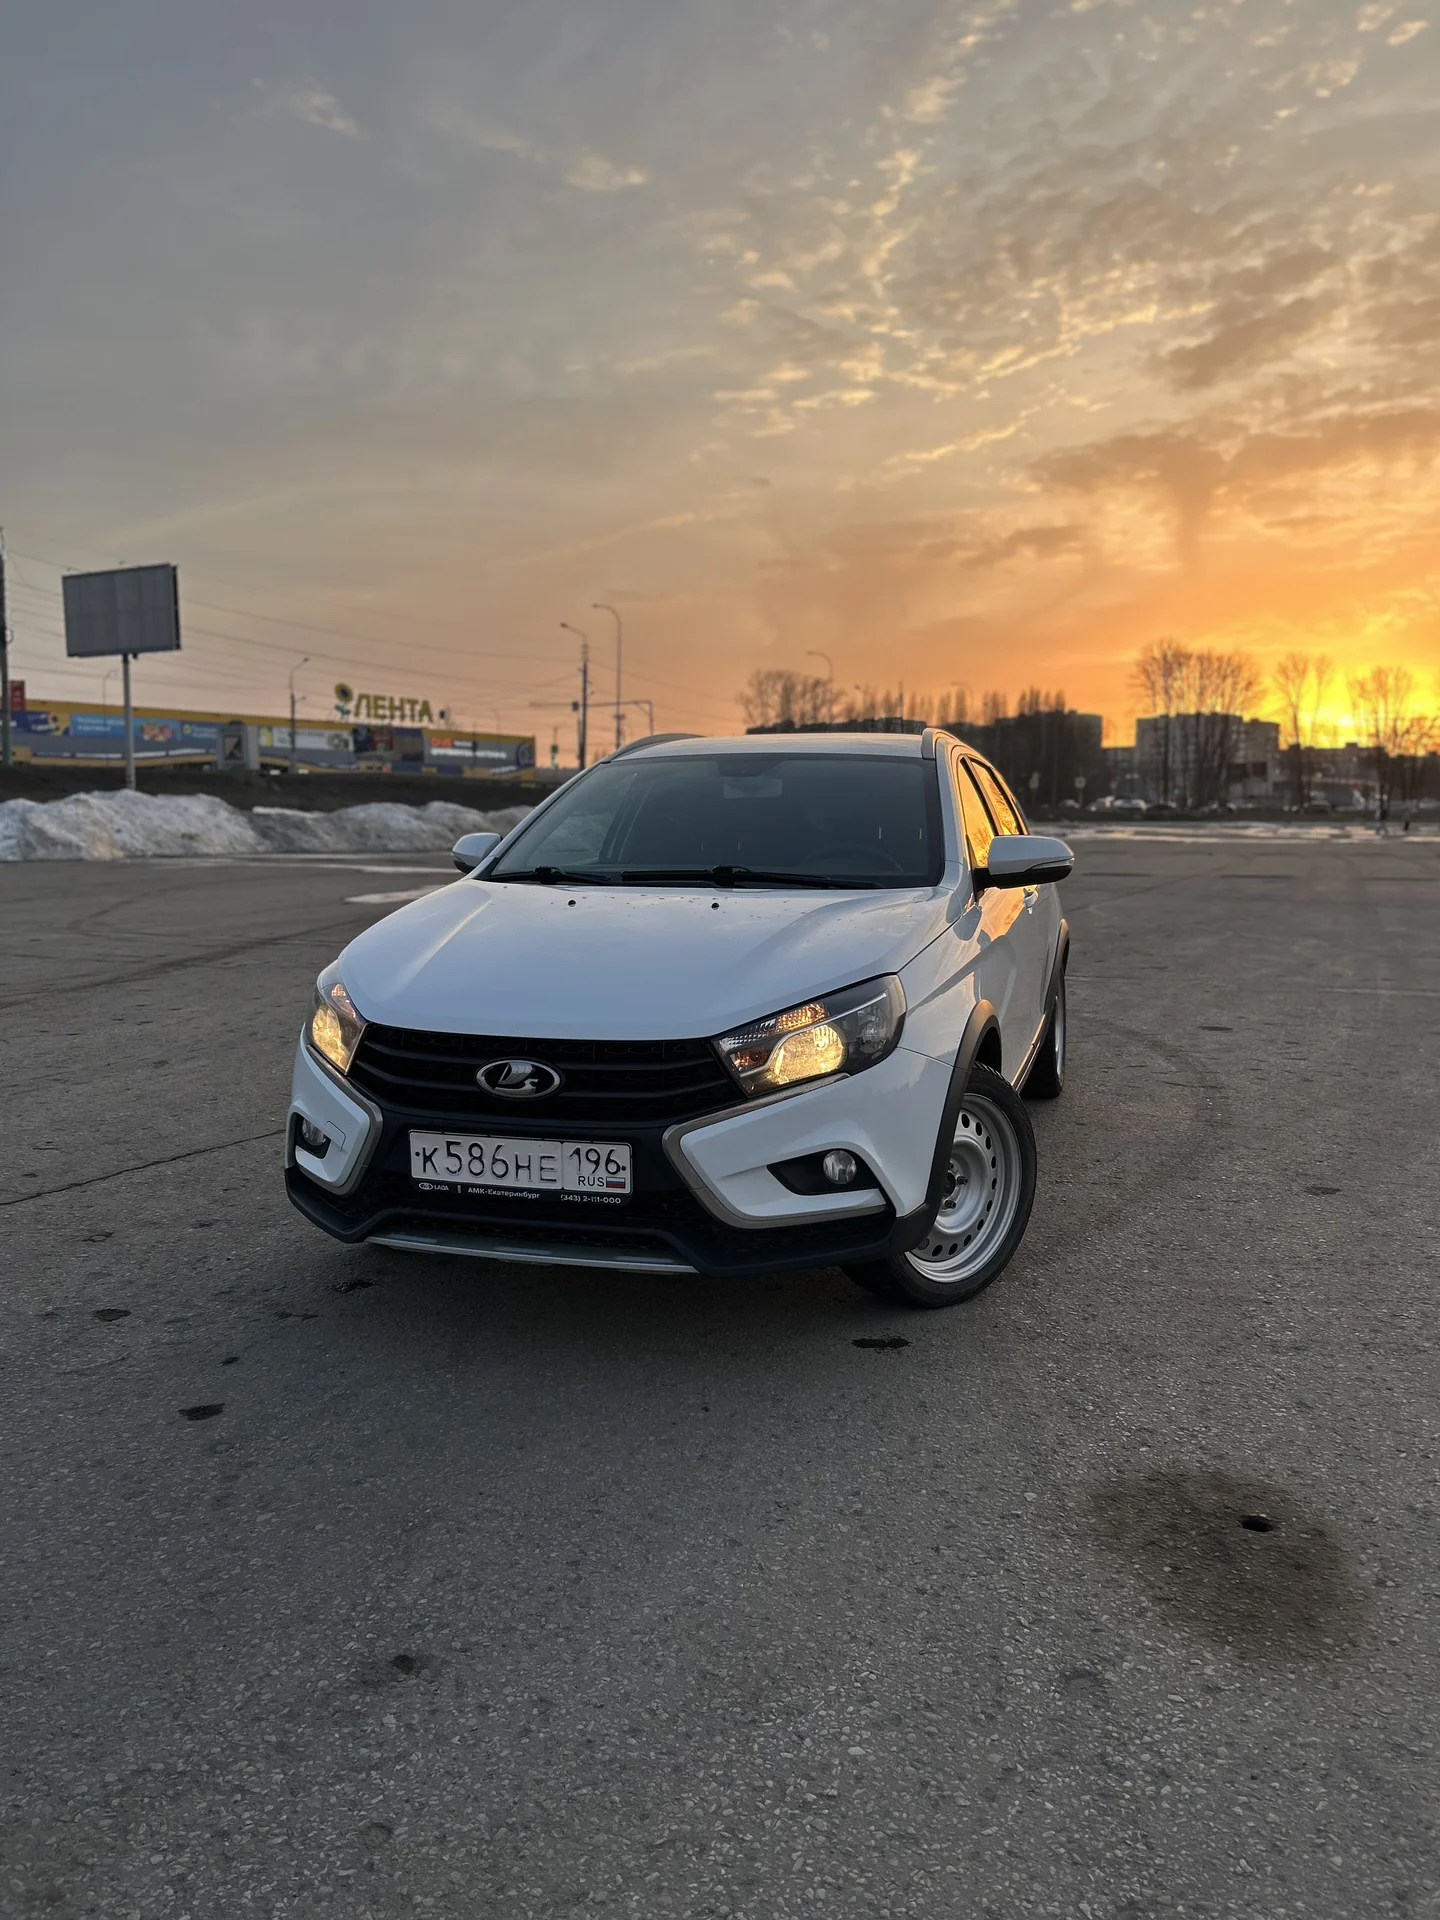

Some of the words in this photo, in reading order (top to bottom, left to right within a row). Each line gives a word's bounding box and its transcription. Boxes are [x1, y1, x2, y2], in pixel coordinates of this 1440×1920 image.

[354, 693, 434, 723] ЛЕНТА
[569, 1147, 621, 1175] 196
[578, 1175, 605, 1187] RUS
[467, 1187, 540, 1199] АМК-Екатеринбург
